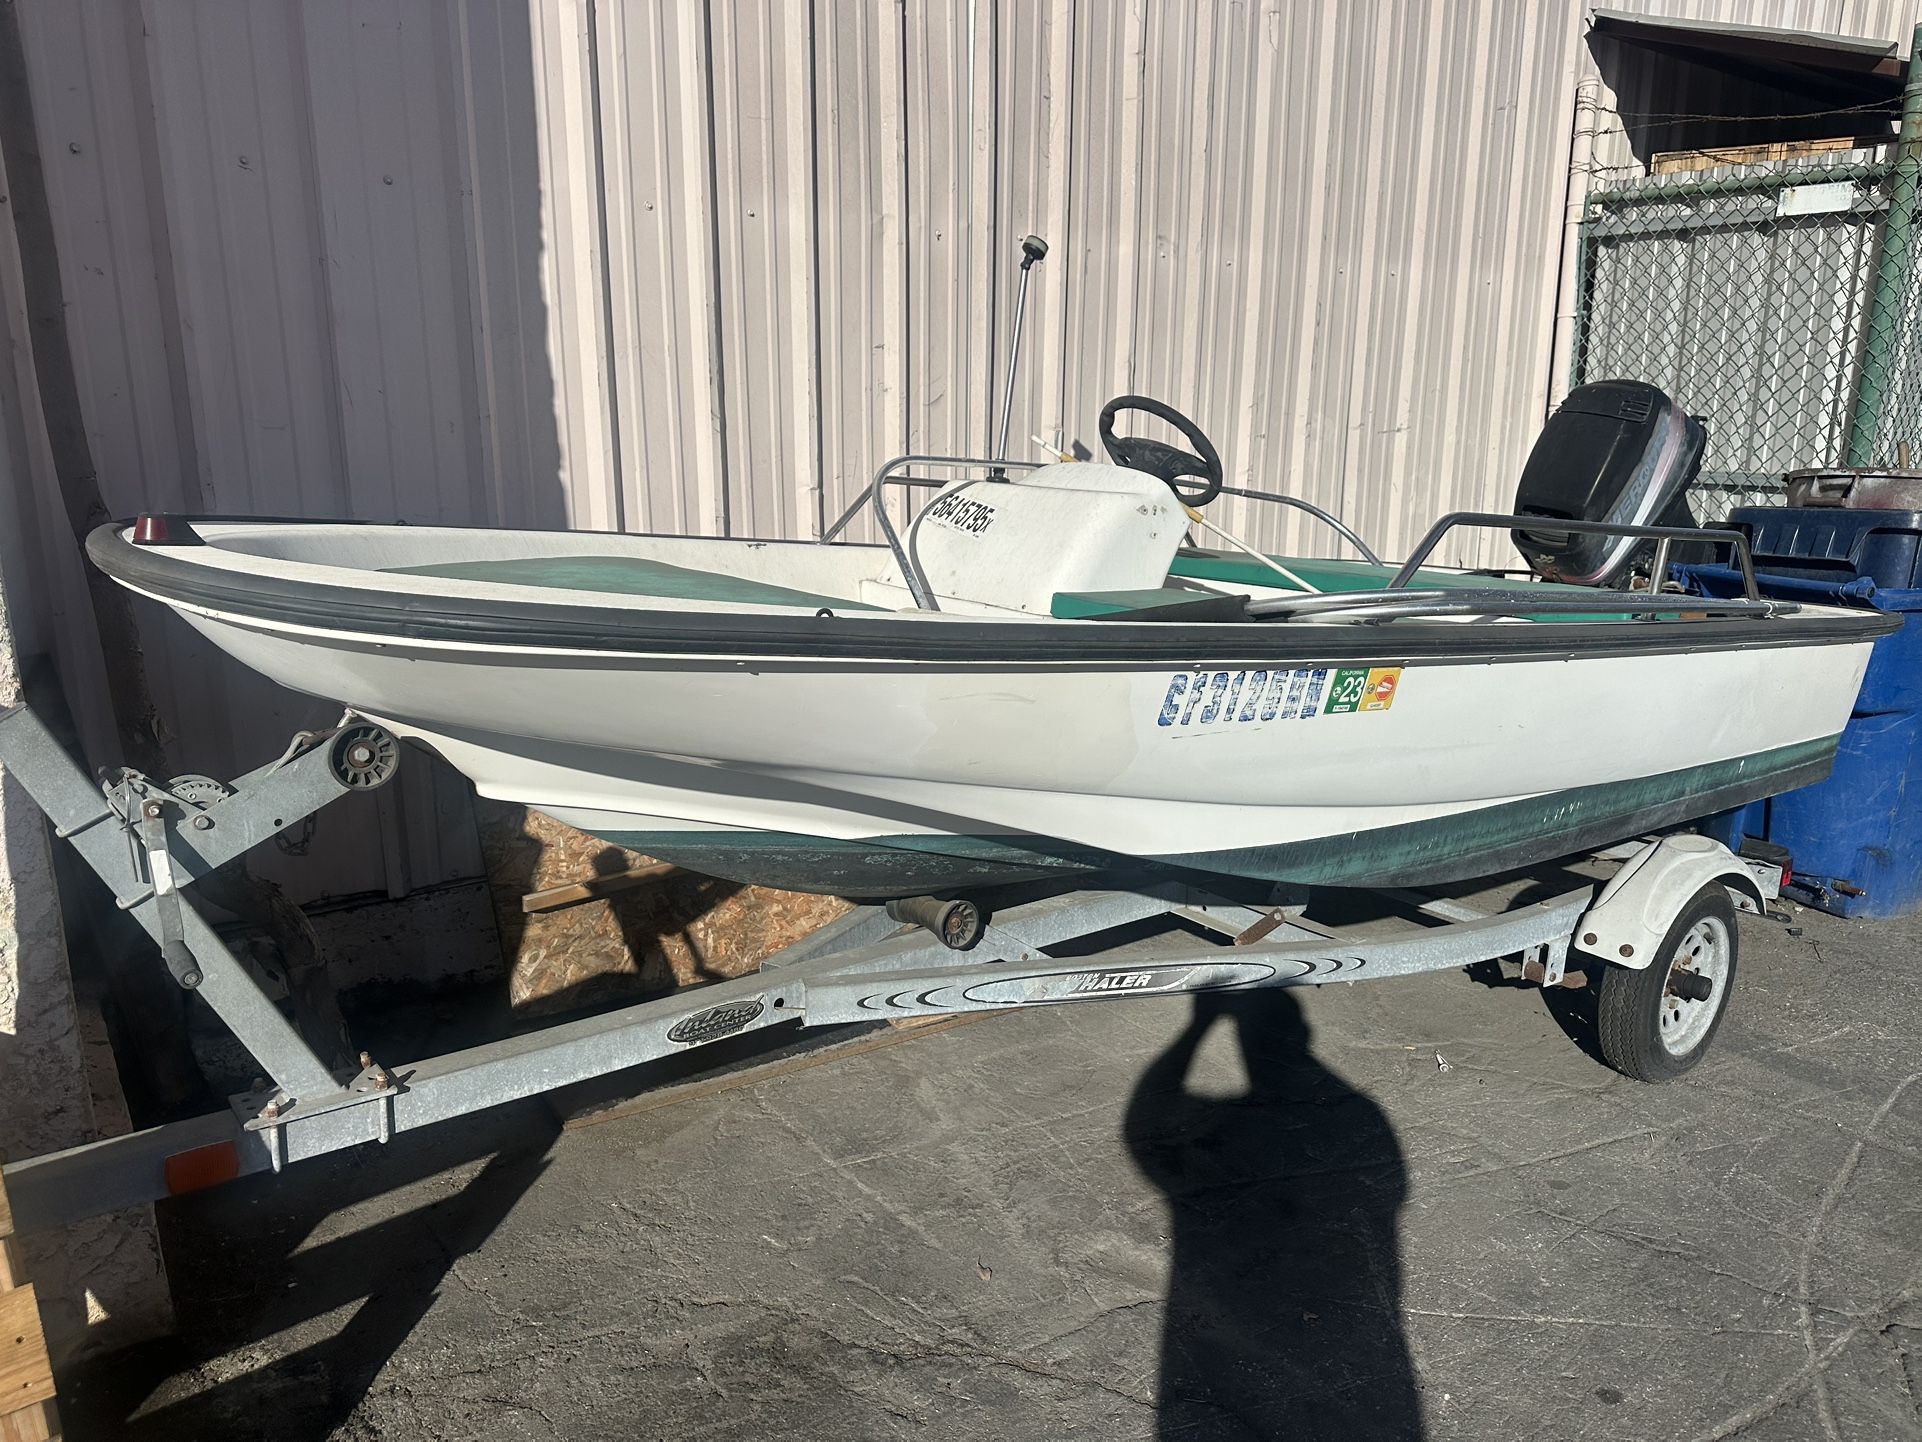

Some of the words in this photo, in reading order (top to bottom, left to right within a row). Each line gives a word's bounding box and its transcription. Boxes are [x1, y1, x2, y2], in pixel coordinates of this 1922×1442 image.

[1338, 676, 1365, 702] 23
[683, 1027, 711, 1039] BOAT
[714, 1015, 752, 1030] CENTER
